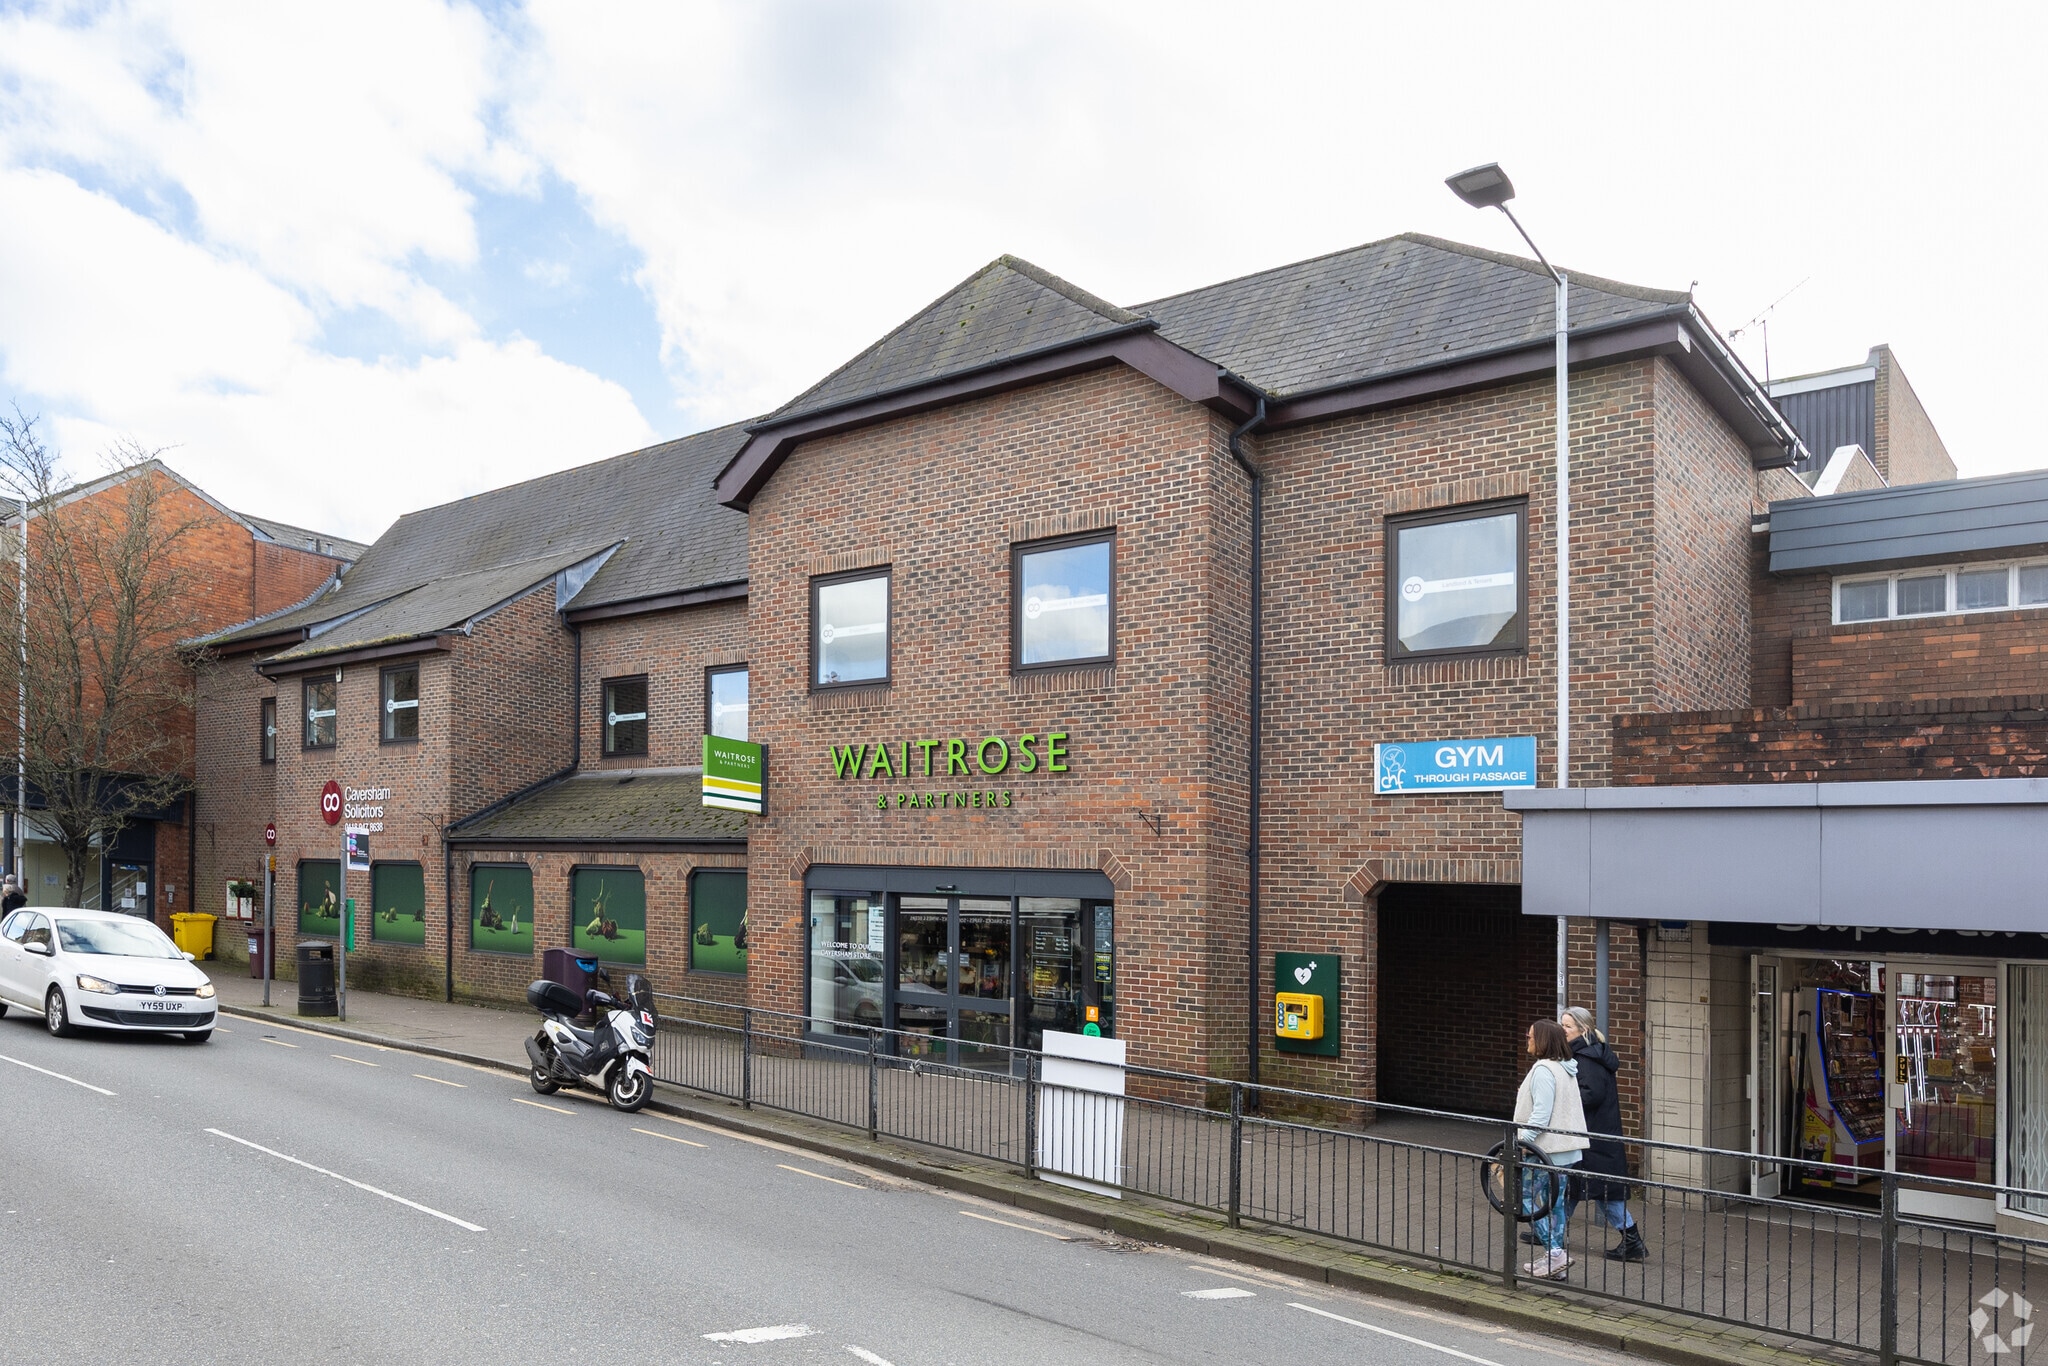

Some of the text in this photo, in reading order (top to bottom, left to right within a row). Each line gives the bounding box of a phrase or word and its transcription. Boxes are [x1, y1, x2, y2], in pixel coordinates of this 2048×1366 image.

[714, 750, 755, 764] WAITROSE
[830, 732, 1070, 780] WAITROSE
[1435, 745, 1504, 768] GYM
[724, 760, 750, 769] PARTNERS
[1414, 771, 1527, 783] THROUGH PASSAGE
[345, 786, 391, 801] Caversham
[877, 790, 1012, 809] & PARTNERS
[345, 803, 383, 819] Solicitors
[820, 941, 849, 949] WELCOME
[820, 949, 852, 958] CAVERSHAM
[141, 1001, 183, 1011] YY59 UXP
